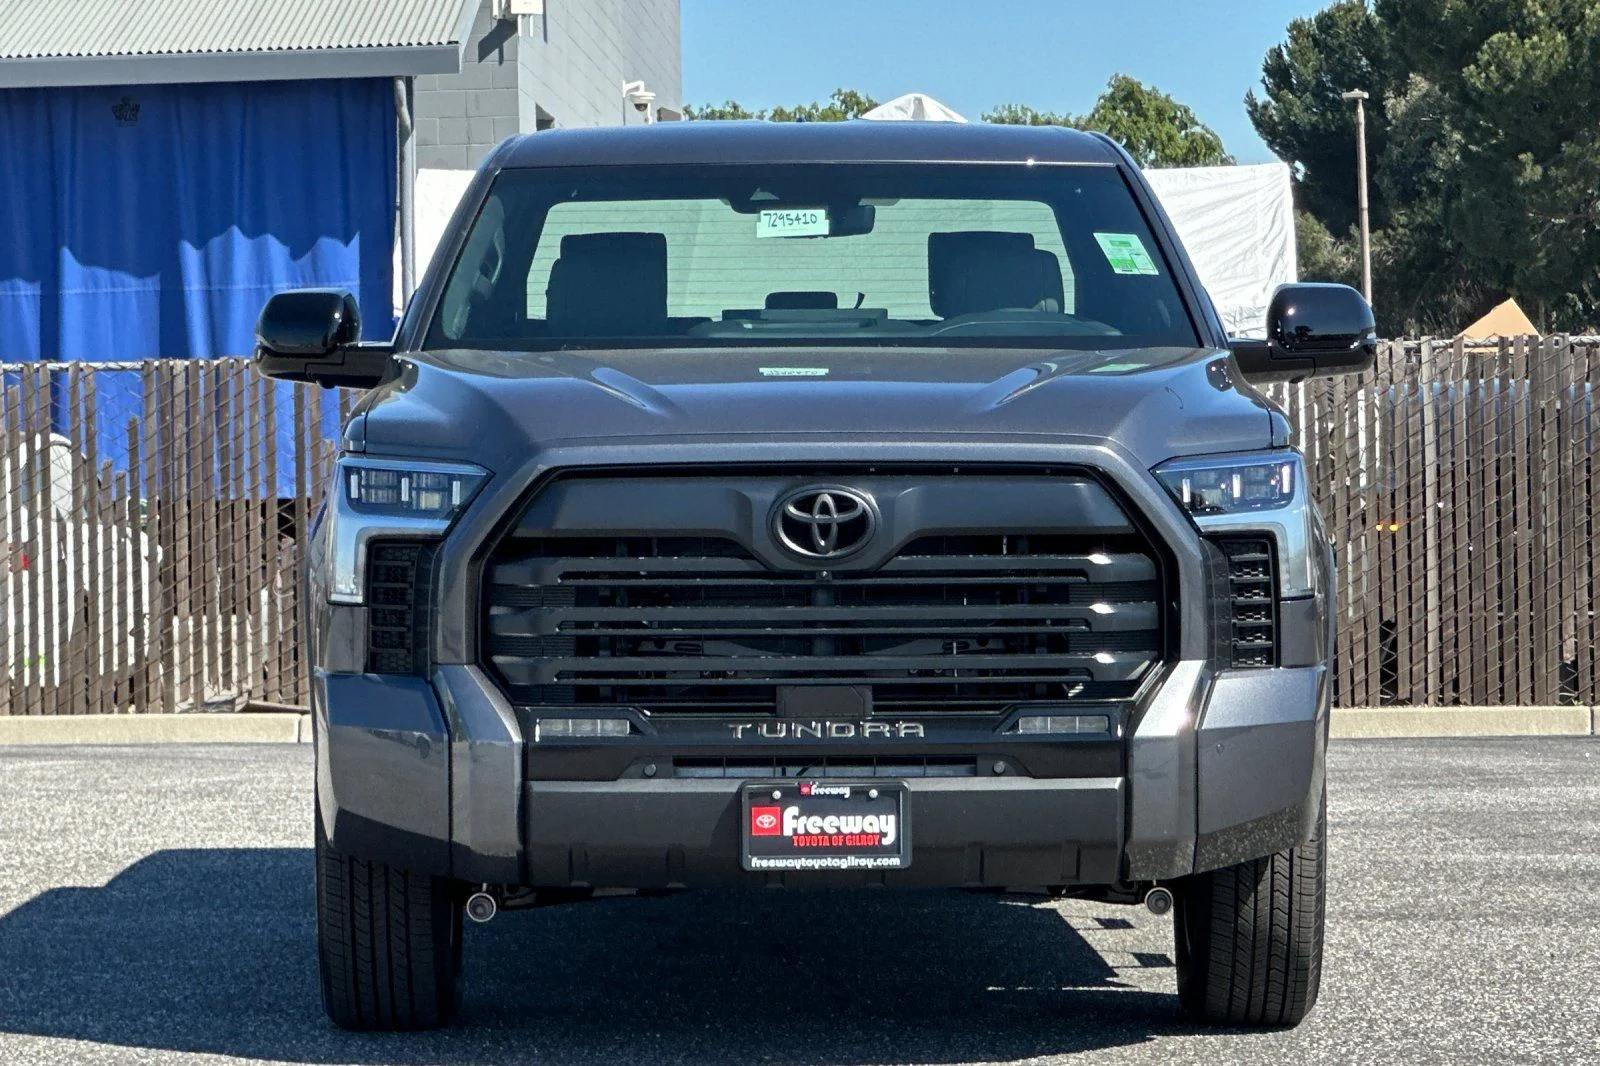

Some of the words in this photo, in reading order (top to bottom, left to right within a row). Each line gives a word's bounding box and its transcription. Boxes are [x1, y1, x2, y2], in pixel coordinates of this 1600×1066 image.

[763, 213, 817, 228] 7295410
[729, 720, 926, 739] TUNDRA
[783, 806, 896, 846] freeway
[792, 835, 830, 847] TOYOTA
[832, 835, 843, 846] OF
[845, 834, 880, 846] GILROY
[751, 856, 900, 870] freewaytoyotagilroy.com
